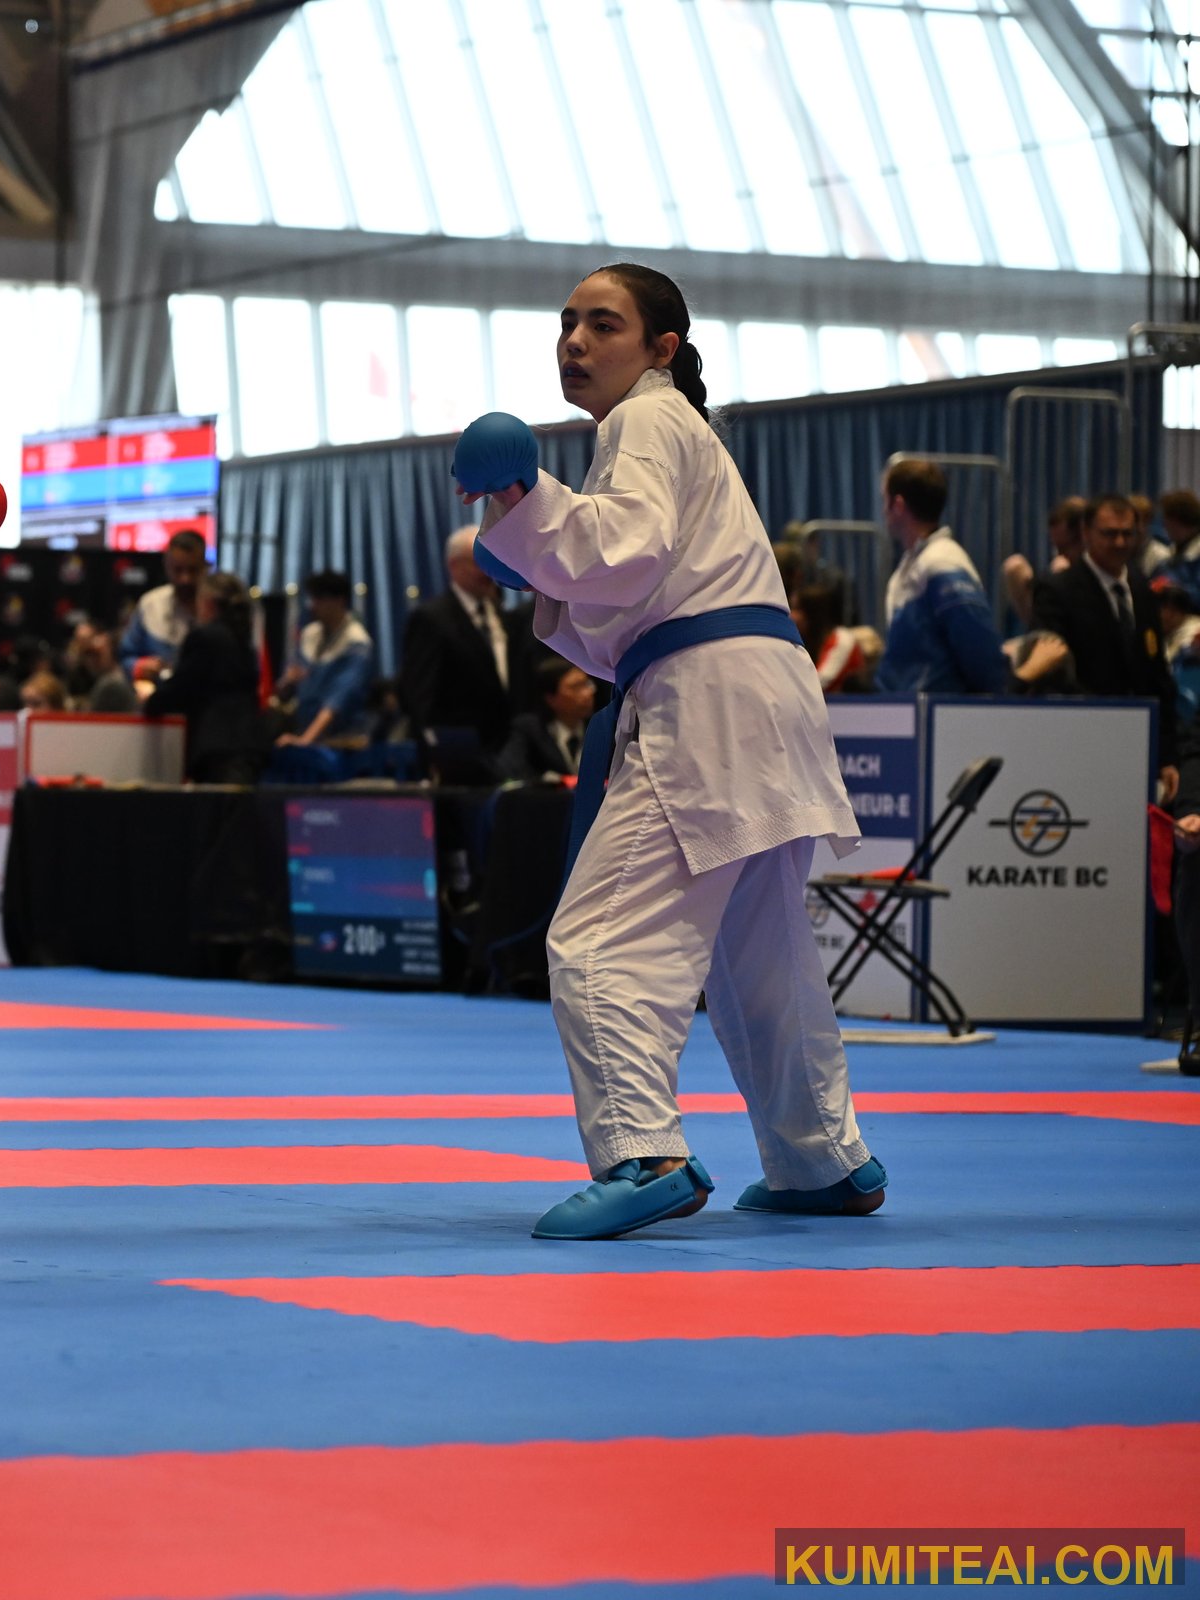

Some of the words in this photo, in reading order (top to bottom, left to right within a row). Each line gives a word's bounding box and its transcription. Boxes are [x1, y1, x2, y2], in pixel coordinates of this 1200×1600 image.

[837, 754, 881, 778] ACH
[967, 866, 1068, 887] KARATE
[1075, 866, 1108, 888] BC
